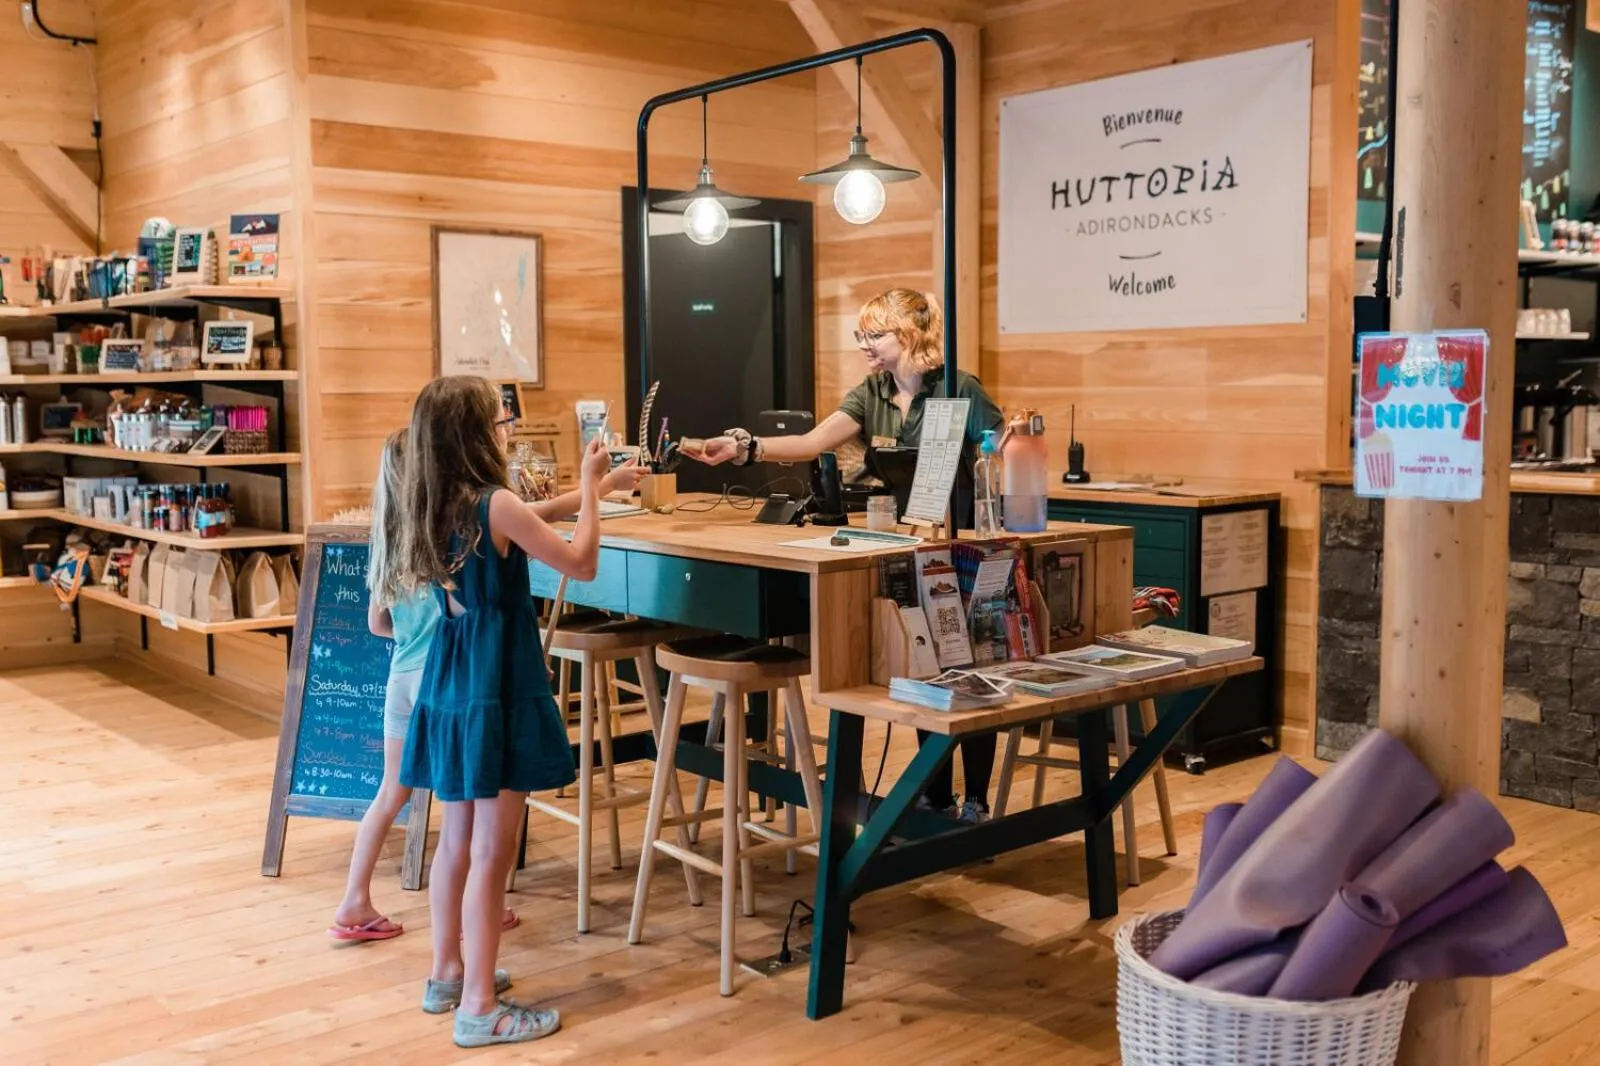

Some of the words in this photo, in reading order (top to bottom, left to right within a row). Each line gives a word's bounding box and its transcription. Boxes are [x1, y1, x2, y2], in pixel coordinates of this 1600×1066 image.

[1103, 108, 1183, 137] Bienvenue
[1076, 207, 1213, 237] ADIRONDACKS
[1108, 272, 1176, 297] Welcome
[1375, 404, 1467, 429] NIGHT
[311, 674, 359, 695] Saturday
